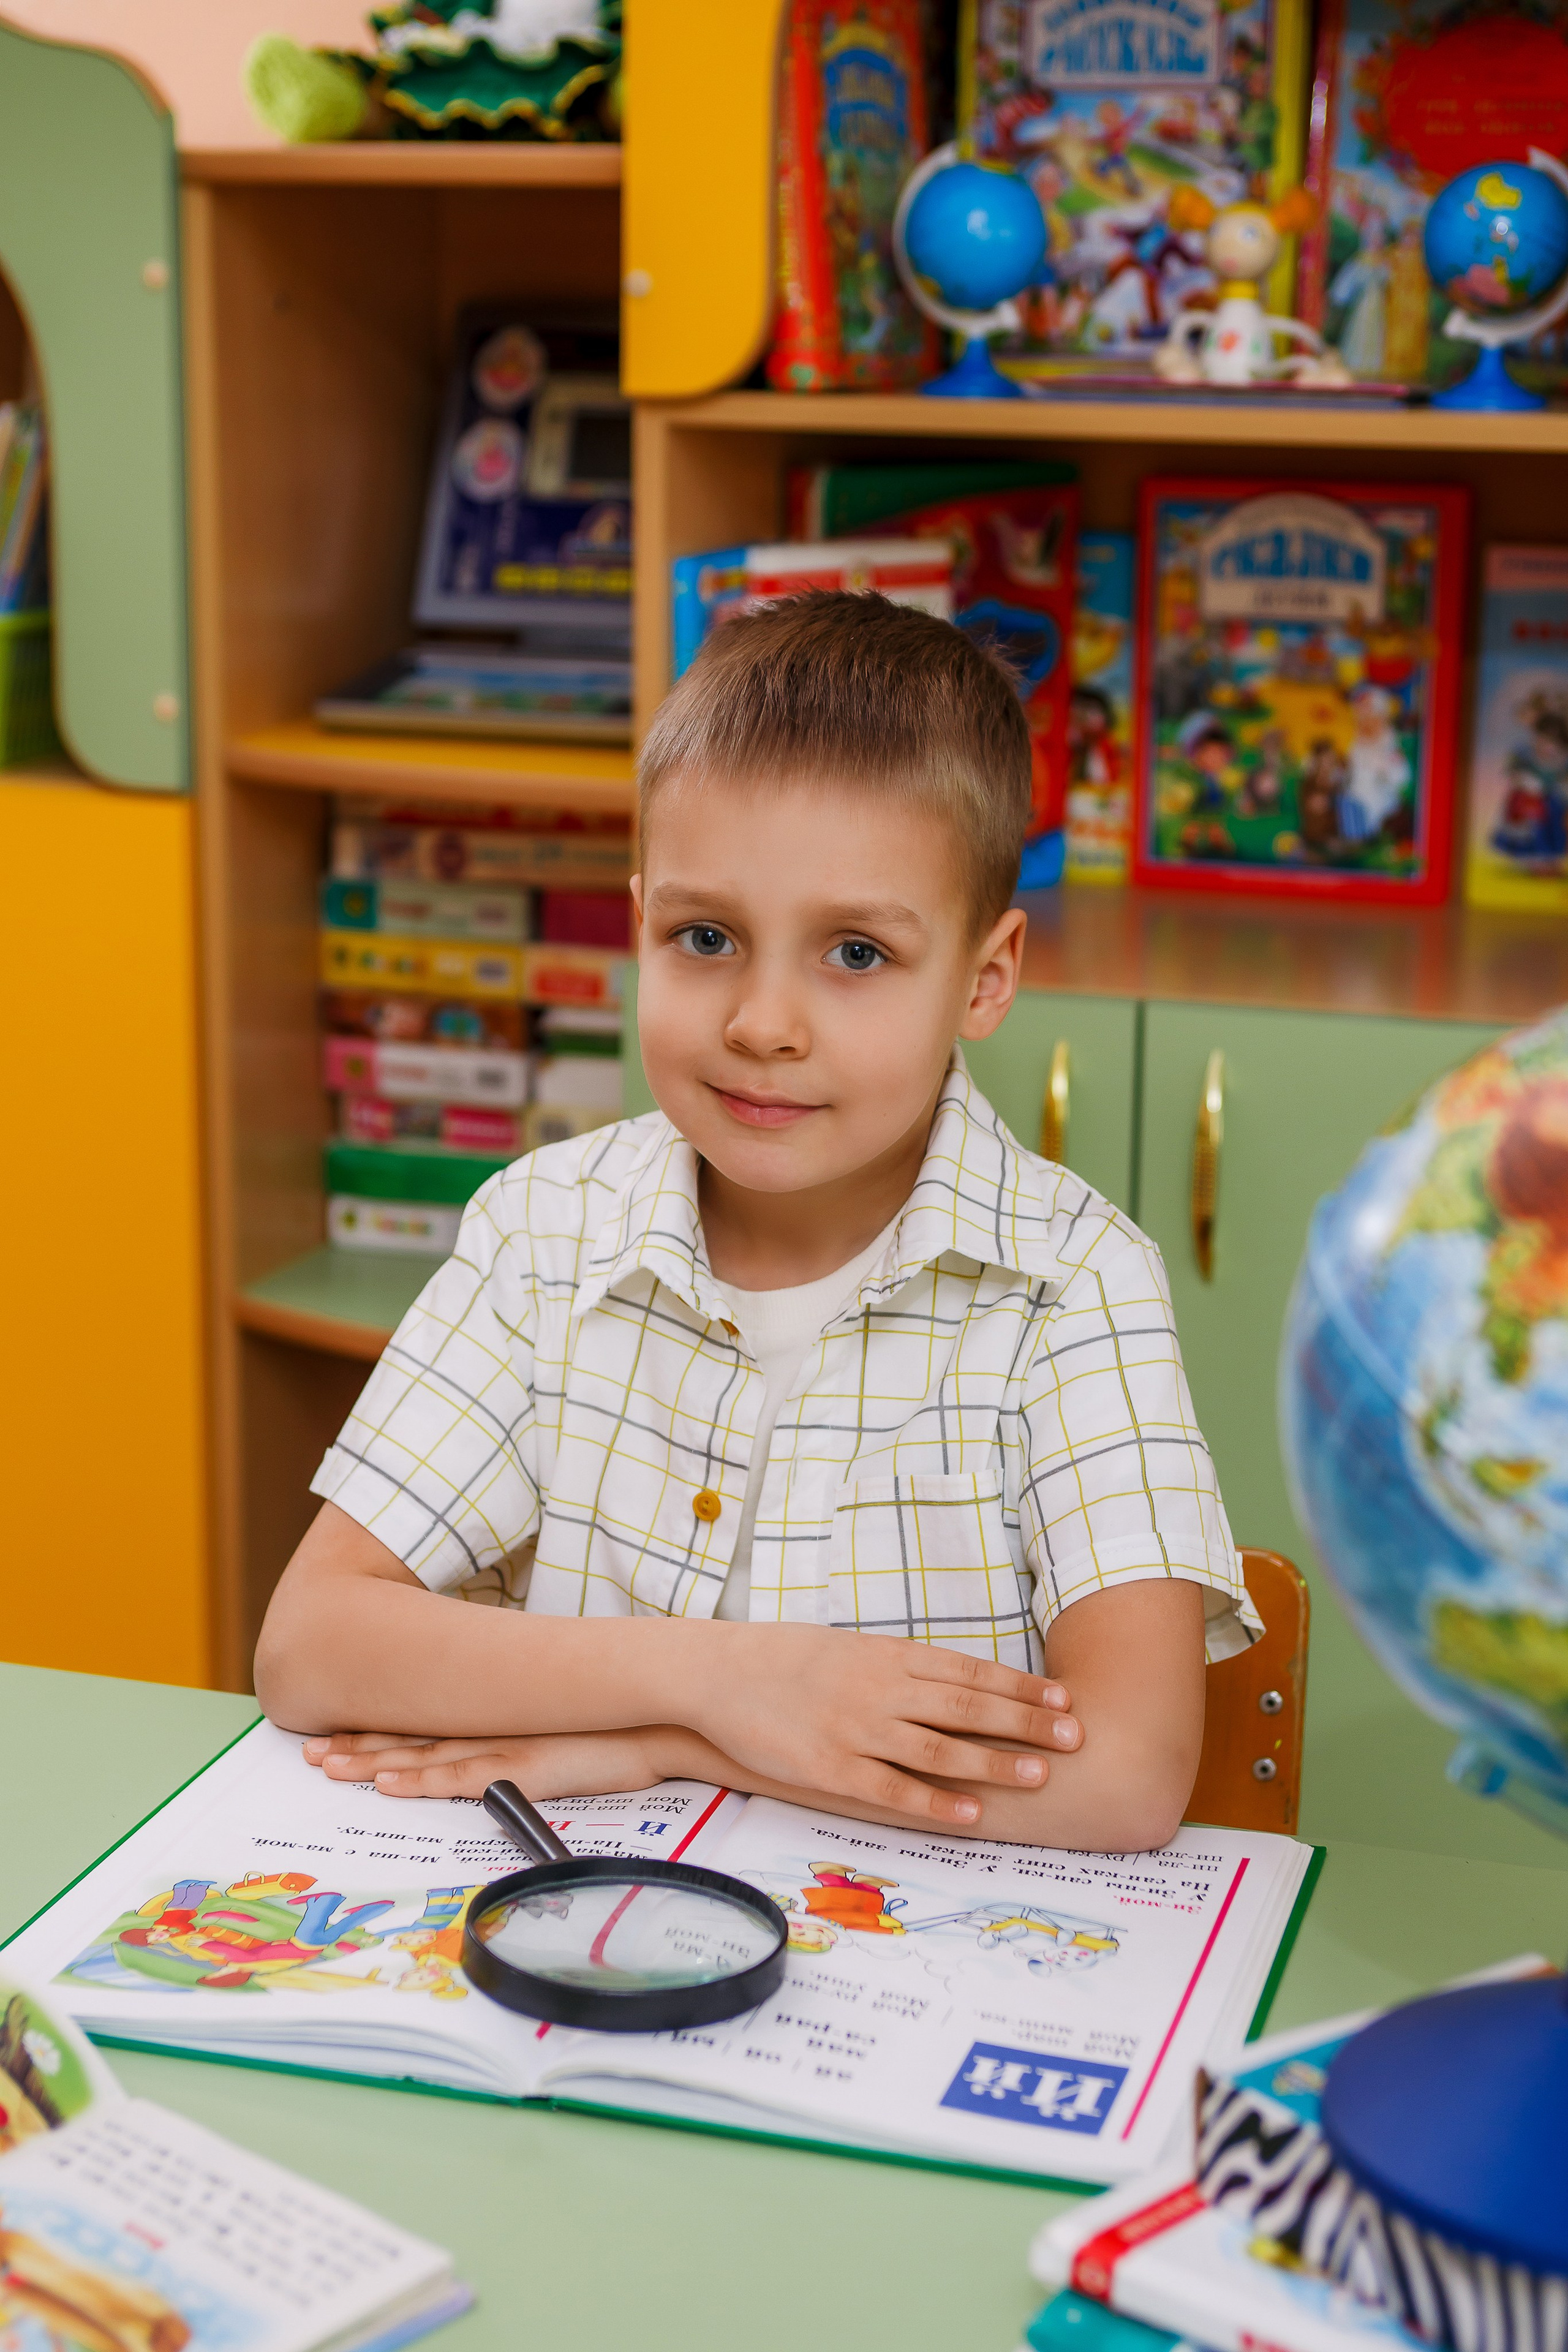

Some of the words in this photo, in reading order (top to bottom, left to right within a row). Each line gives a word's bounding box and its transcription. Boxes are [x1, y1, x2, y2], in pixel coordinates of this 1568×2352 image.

[543, 1803, 628, 1812] ша-рик.
[639, 1803, 687, 1815] Мой
[646, 1796, 693, 1806] Мои
[336, 1827, 443, 1844] ма-ши-ну.
[633, 1820, 672, 1836] Й
[251, 1838, 334, 1853] ма-мой.
[810, 1827, 887, 1851] зай-ка.
[369, 1852, 441, 1864] Ма-ша
[898, 1849, 968, 1869] Зи-ны
[925, 1844, 1003, 1861] зай-ка.
[978, 1864, 997, 1873] У
[1012, 1868, 1092, 1885] сан-ки.
[1078, 1868, 1166, 1885] сан-ках
[1106, 1882, 1177, 1899] Зи-ны
